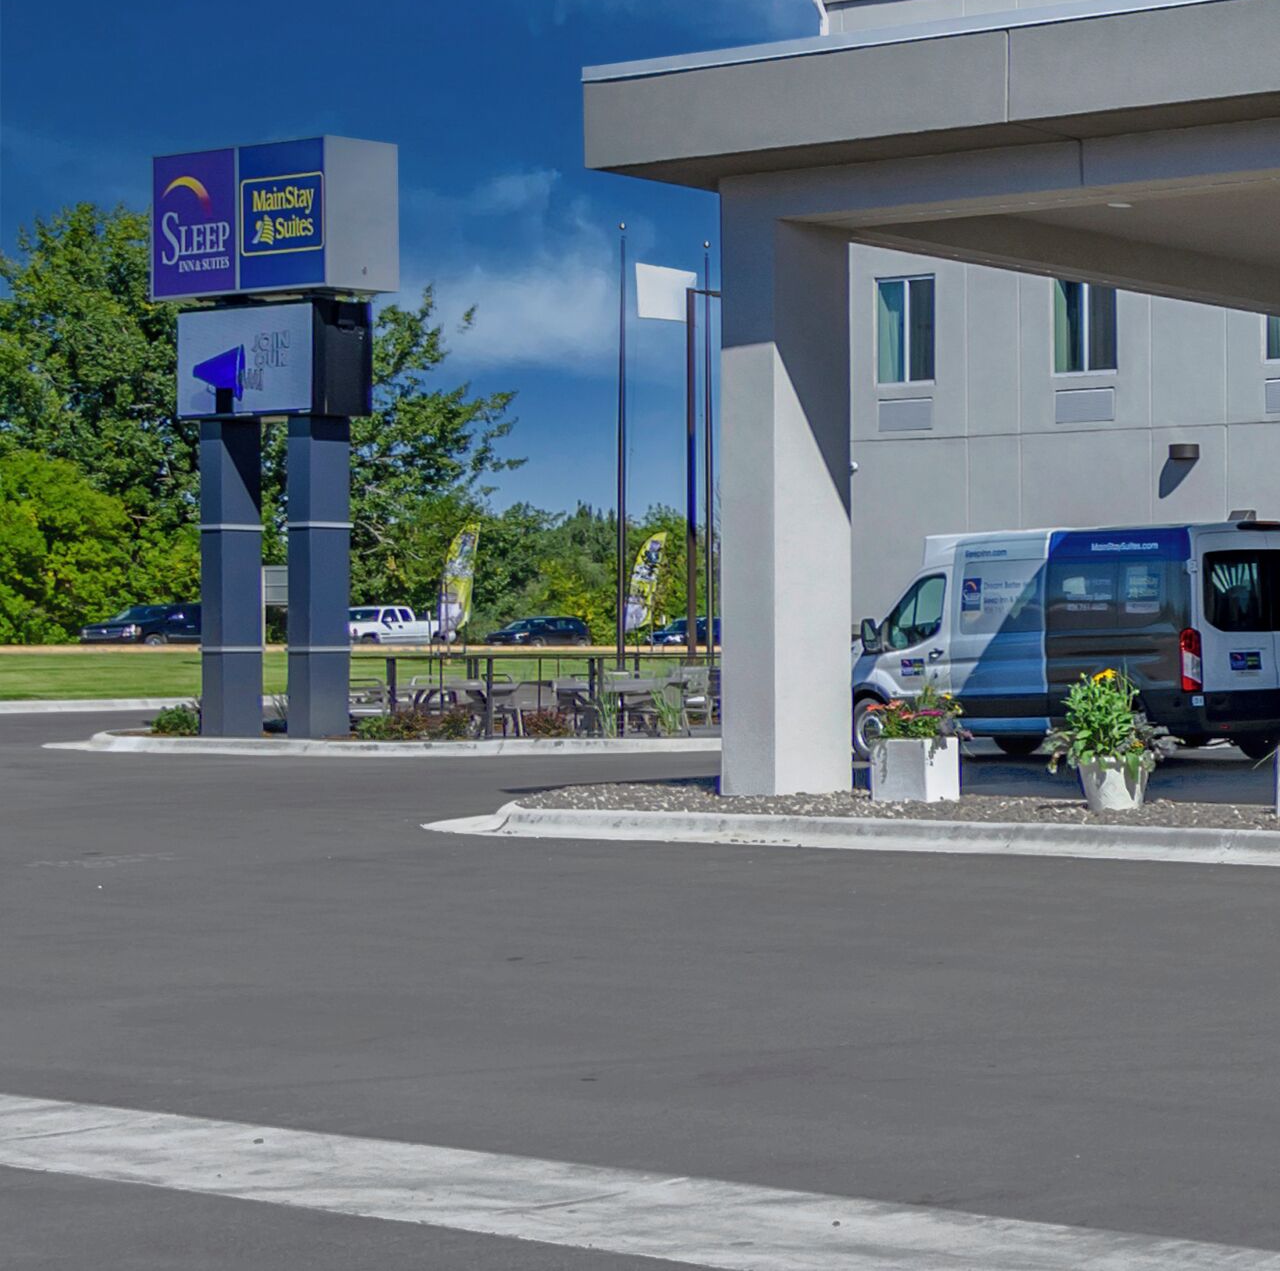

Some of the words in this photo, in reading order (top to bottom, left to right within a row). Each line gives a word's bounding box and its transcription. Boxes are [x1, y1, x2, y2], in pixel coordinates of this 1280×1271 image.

[252, 185, 315, 215] MainStay
[161, 211, 230, 265] SLEEP
[275, 214, 314, 239] Suites
[178, 260, 195, 273] INN
[202, 256, 230, 271] SUITES
[251, 330, 290, 353] JOIN
